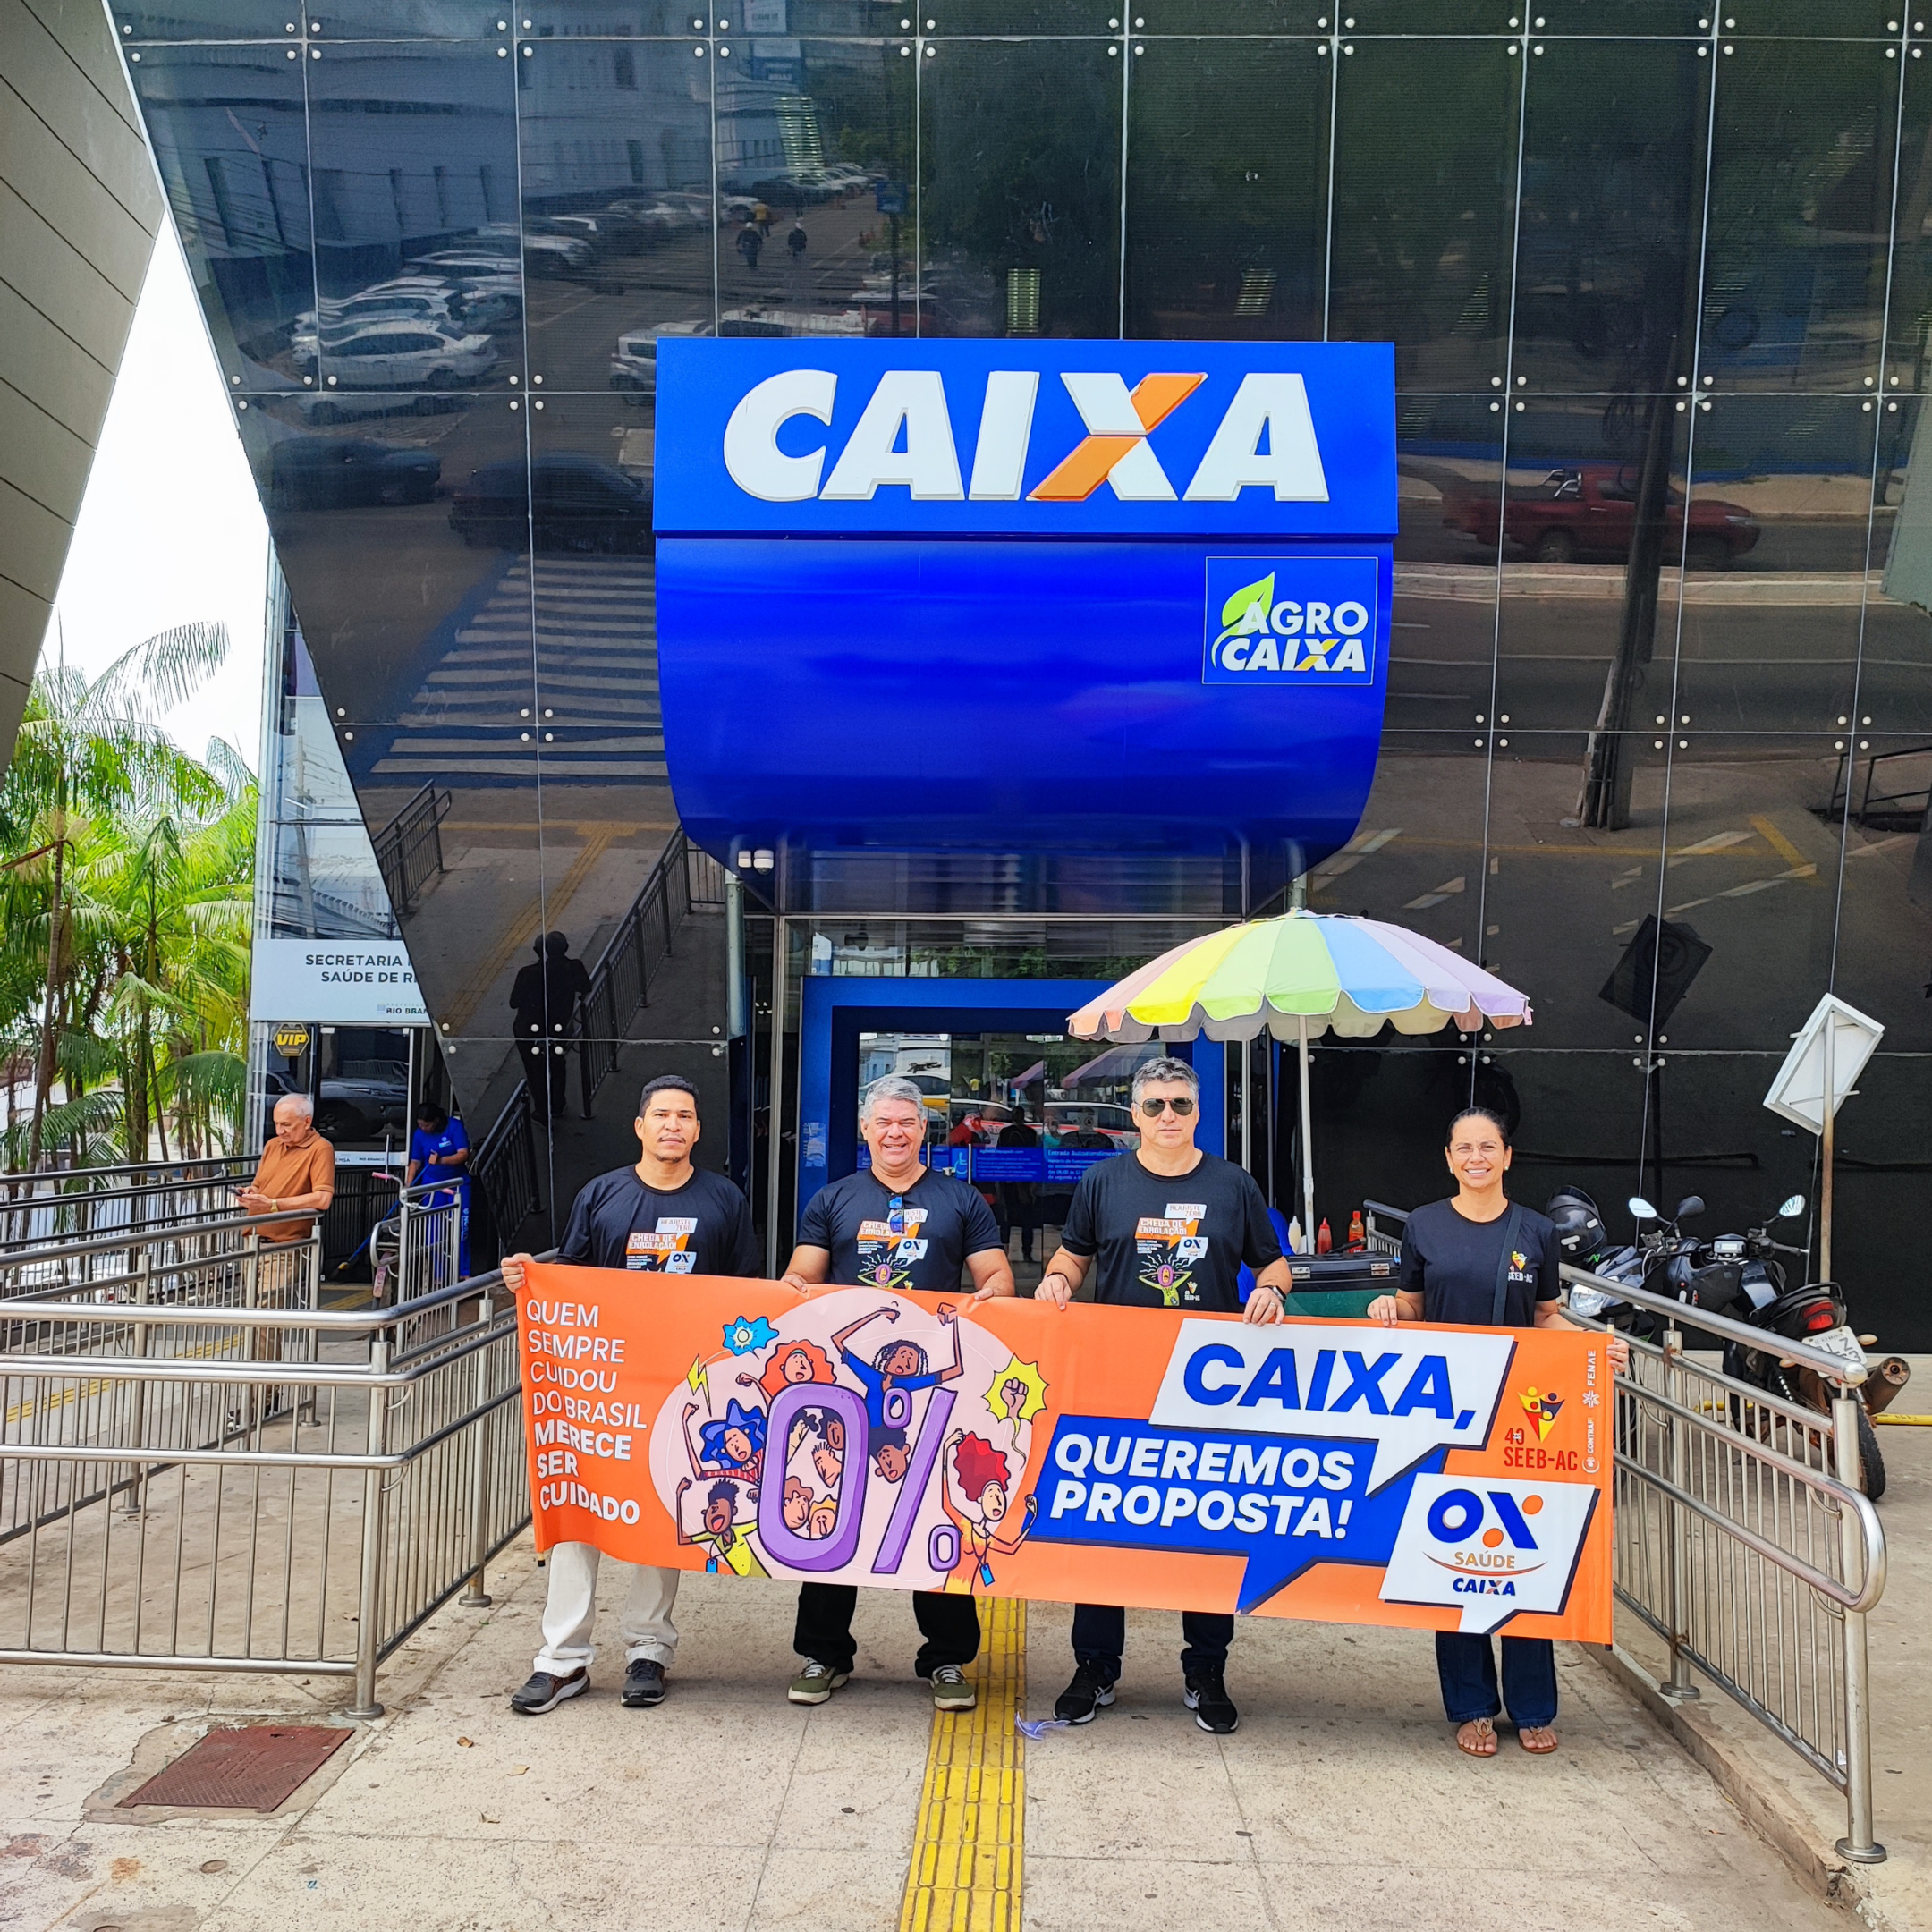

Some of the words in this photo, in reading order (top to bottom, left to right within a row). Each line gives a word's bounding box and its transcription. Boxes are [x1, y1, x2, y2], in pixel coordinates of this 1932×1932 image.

[724, 369, 1330, 502] CAIXA
[1236, 601, 1368, 635] AGRO
[1221, 638, 1366, 672] CAIXA
[305, 954, 402, 967] SECRETARIA
[321, 969, 374, 983] SAÚDE
[378, 971, 399, 983] DE
[277, 1033, 307, 1046] VIP
[526, 1299, 599, 1328] QUEM
[528, 1329, 626, 1364] SEMPRE
[530, 1360, 617, 1394] CUIDOU
[1587, 1350, 1597, 1387] FENAE
[1183, 1343, 1477, 1431] CAIXA,
[532, 1390, 563, 1415] DO
[564, 1395, 648, 1429] BRASIL
[534, 1419, 632, 1461] MERECE
[537, 1450, 580, 1479] SER
[1055, 1433, 1356, 1492] QUEREMOS
[1504, 1445, 1579, 1472] SEEB-AC
[539, 1480, 640, 1525] CUIDADO
[1049, 1479, 1354, 1540] PROPOSTA!
[1453, 1550, 1516, 1570] SAÚDE
[1453, 1577, 1517, 1597] CAIXA
